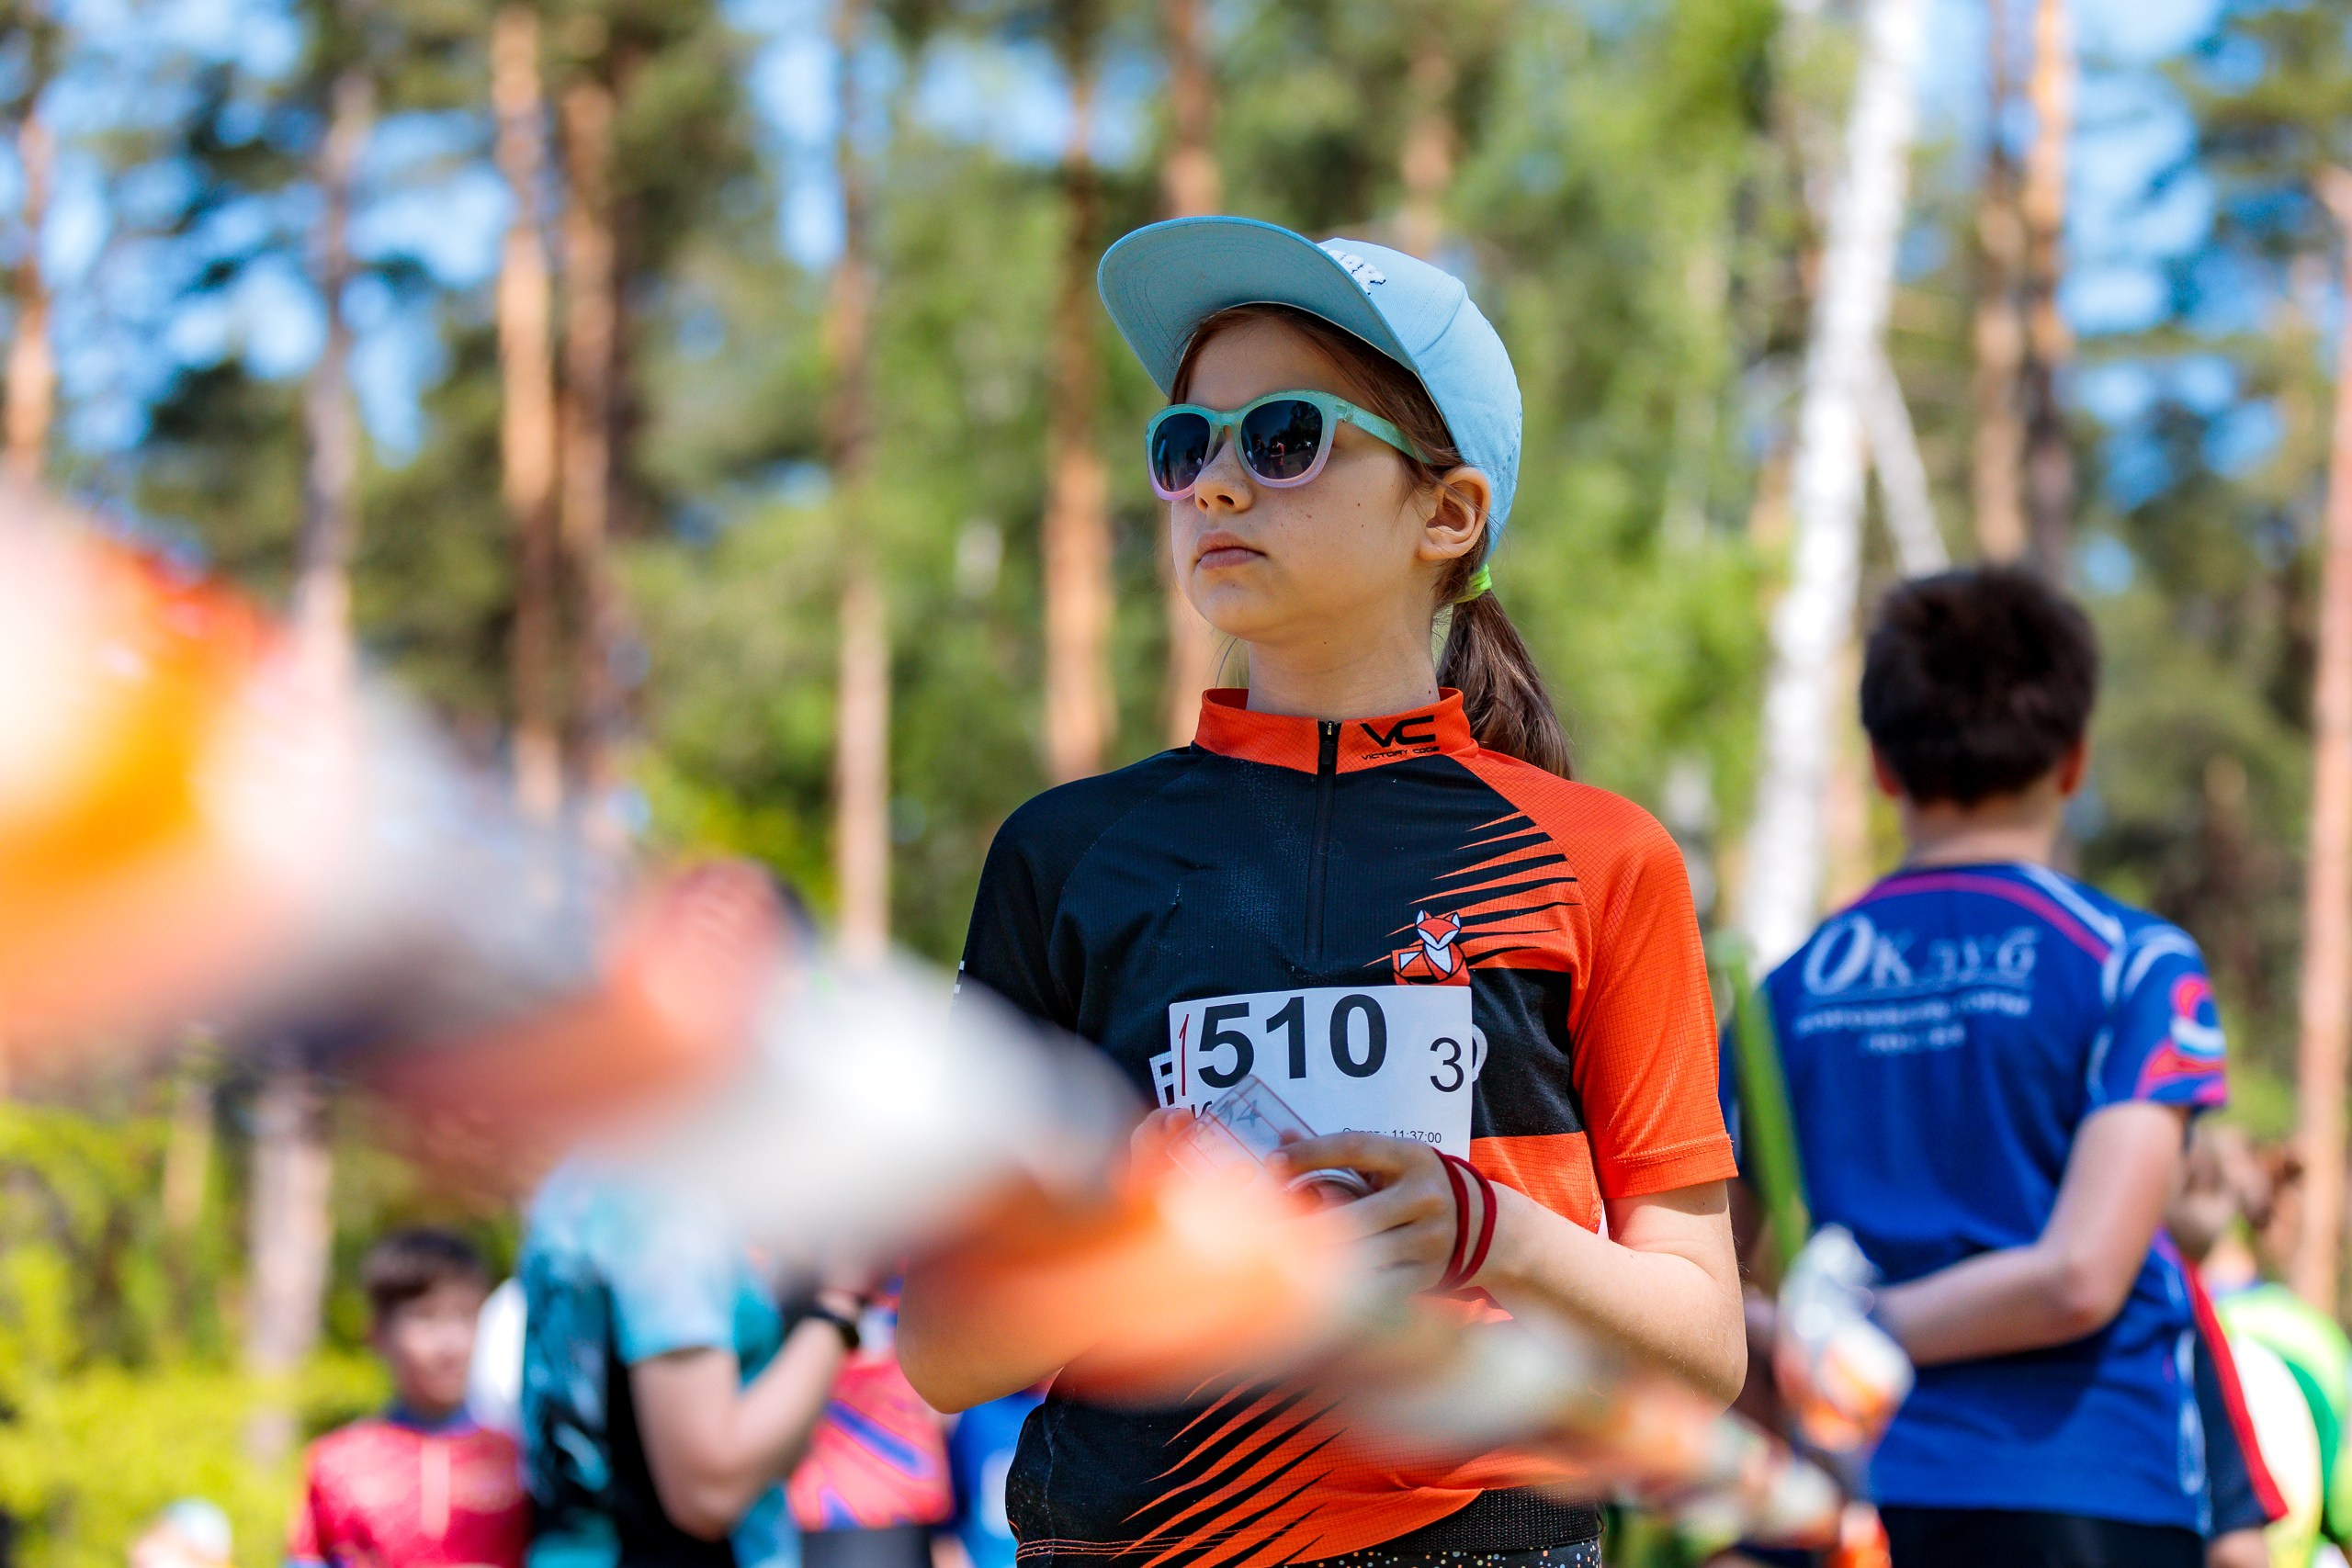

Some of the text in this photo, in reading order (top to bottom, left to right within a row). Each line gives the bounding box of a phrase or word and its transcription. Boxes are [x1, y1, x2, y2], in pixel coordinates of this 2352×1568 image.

[1360, 716, 1436, 747] VC
[1361, 749, 1408, 761] VICTORY
[1197, 993, 1388, 1089] 510
[1429, 1036, 1464, 1093] 3
[1392, 1129, 1442, 1144] 11:37:00
